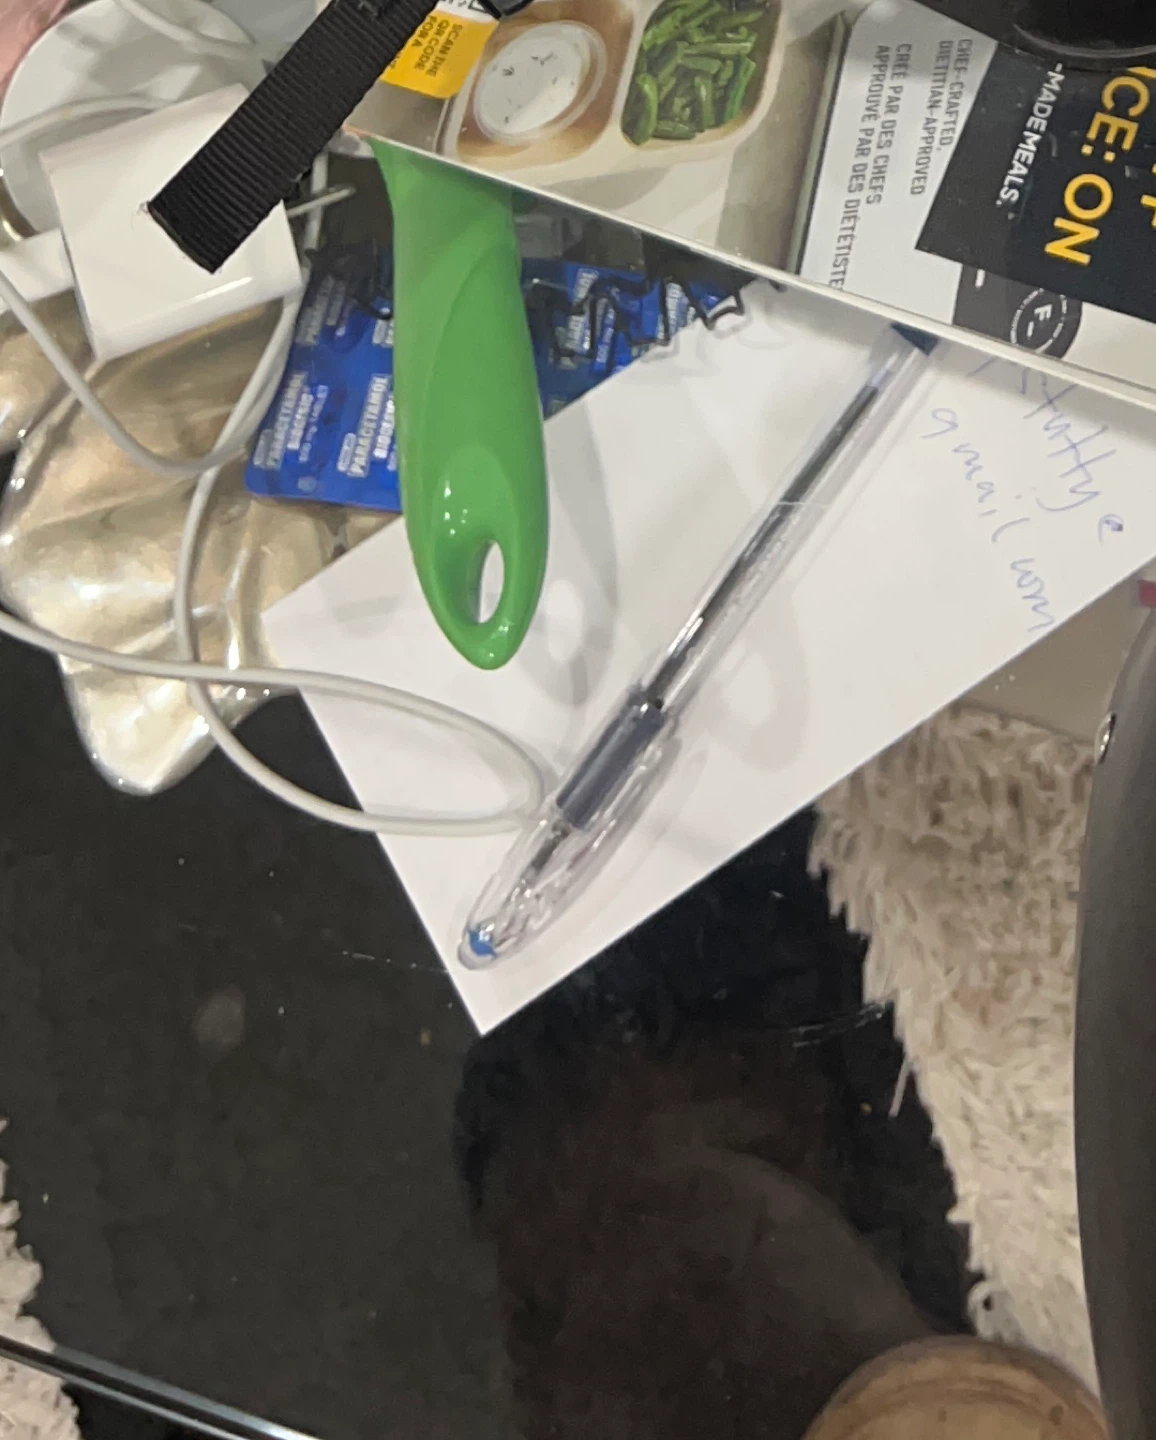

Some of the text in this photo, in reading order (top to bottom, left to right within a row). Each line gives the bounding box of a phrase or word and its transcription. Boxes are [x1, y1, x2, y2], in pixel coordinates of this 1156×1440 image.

[439, 23, 462, 55] SCAN
[883, 86, 903, 113] PAR
[854, 128, 874, 157] PAR
[876, 120, 896, 149] DES
[847, 164, 867, 192] DES
[865, 155, 890, 204] CHEFS
[995, 129, 1039, 206] MEALS.
[1044, 174, 1112, 265] ON
